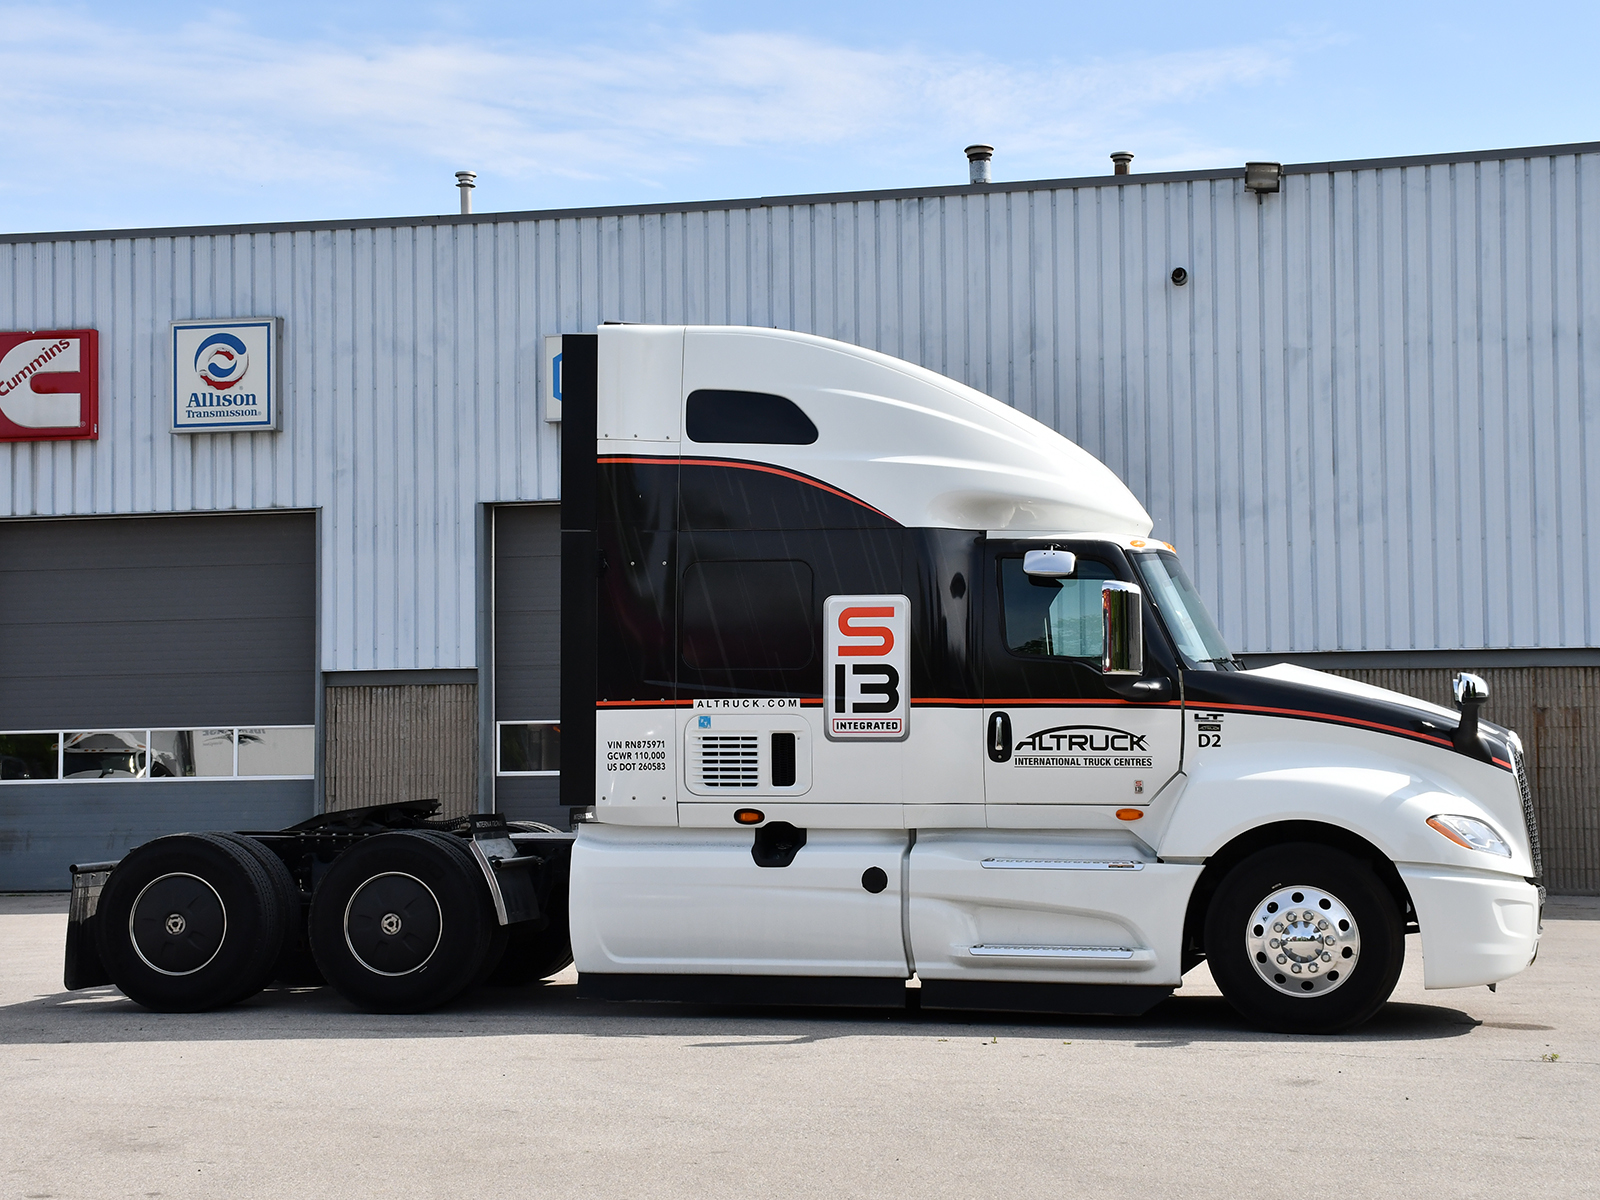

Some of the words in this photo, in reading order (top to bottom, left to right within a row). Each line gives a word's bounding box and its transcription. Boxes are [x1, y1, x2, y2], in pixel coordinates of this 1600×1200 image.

[0, 339, 70, 396] Cummins
[186, 392, 257, 408] Allison
[185, 408, 258, 418] Transmission
[838, 606, 895, 656] S
[835, 664, 900, 713] 13
[697, 699, 797, 708] ALTRUCK.COM
[836, 721, 898, 730] INTEGRATED
[1014, 726, 1150, 751] ALTRUCK
[1198, 734, 1222, 747] D2
[607, 741, 622, 749] VIN
[625, 740, 665, 749] RN875971
[607, 752, 632, 760] GCWR
[635, 751, 666, 760] 110,000
[607, 763, 617, 771] US
[620, 763, 636, 771] DOT
[638, 762, 666, 771] 260583
[1014, 757, 1081, 766] INTERNATIONAL
[1084, 757, 1111, 766] TRUCK
[1114, 757, 1152, 767] CENTRES
